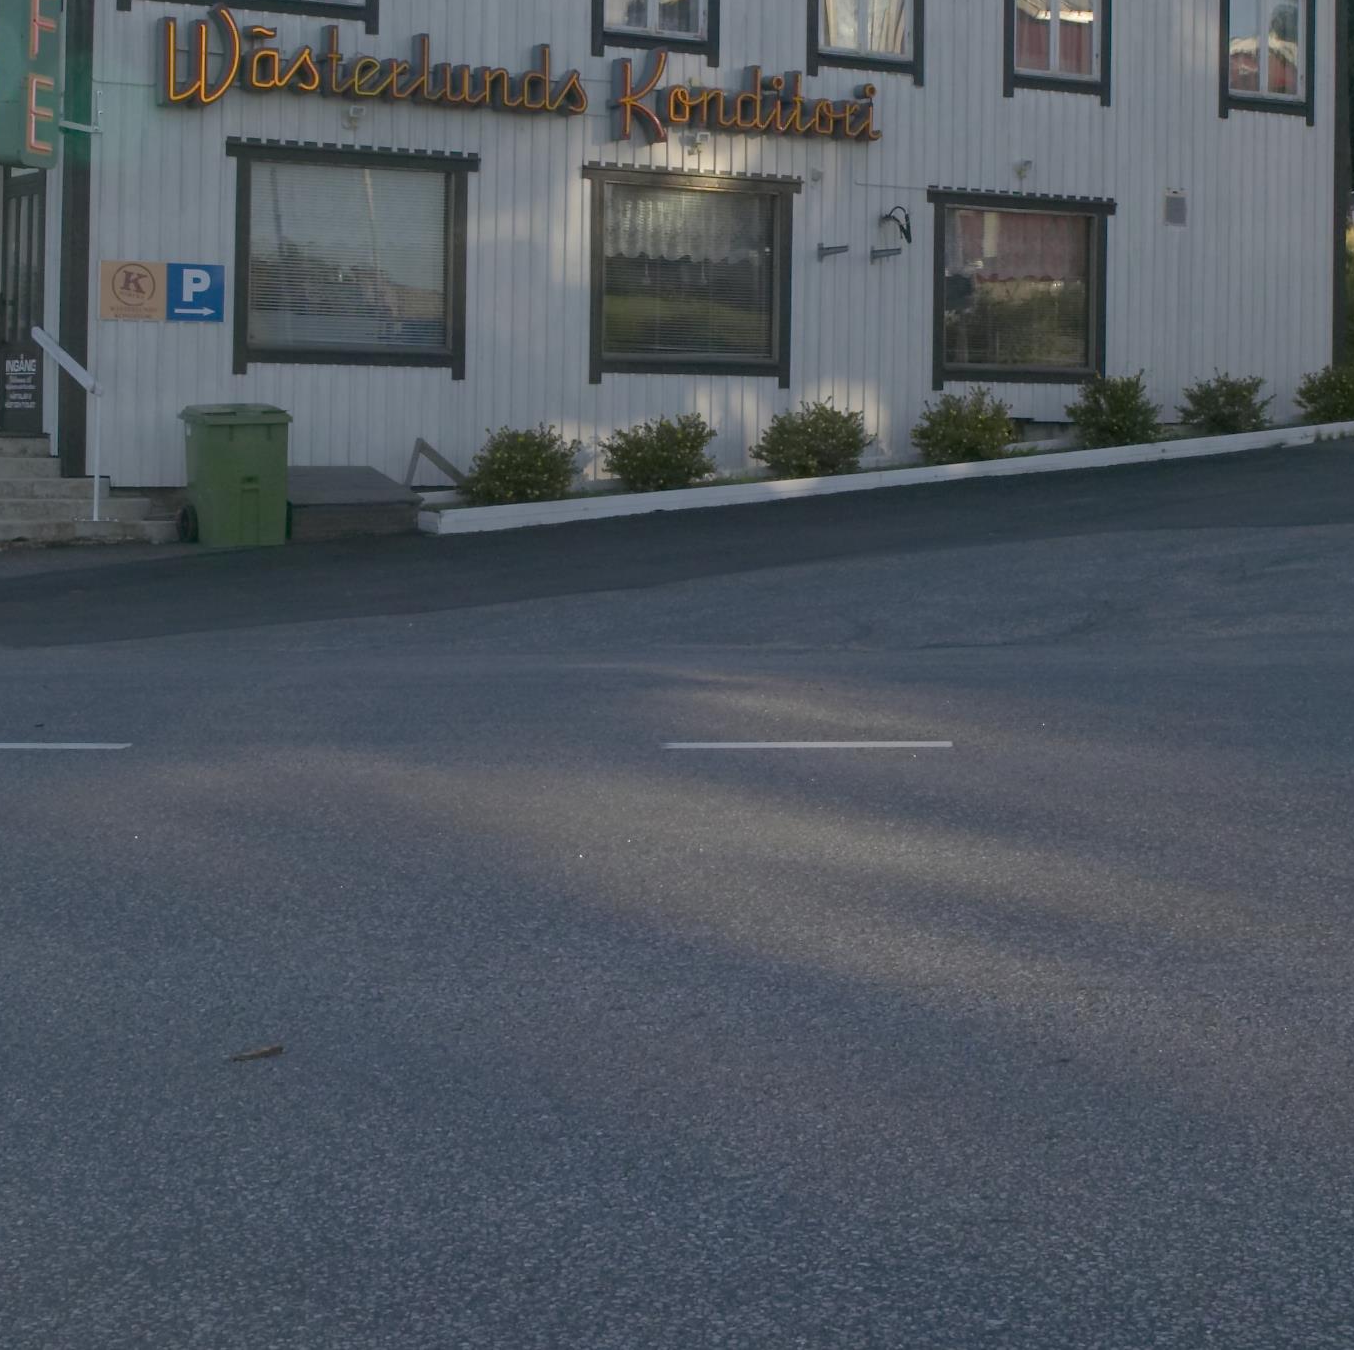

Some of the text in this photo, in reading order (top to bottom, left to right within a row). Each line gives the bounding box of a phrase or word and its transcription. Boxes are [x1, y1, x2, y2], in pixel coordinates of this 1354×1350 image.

[159, 4, 882, 143] Wästerlunds Konditori
[120, 270, 148, 295] K
[182, 269, 211, 302] P
[5, 353, 37, 372] INGÅNG
